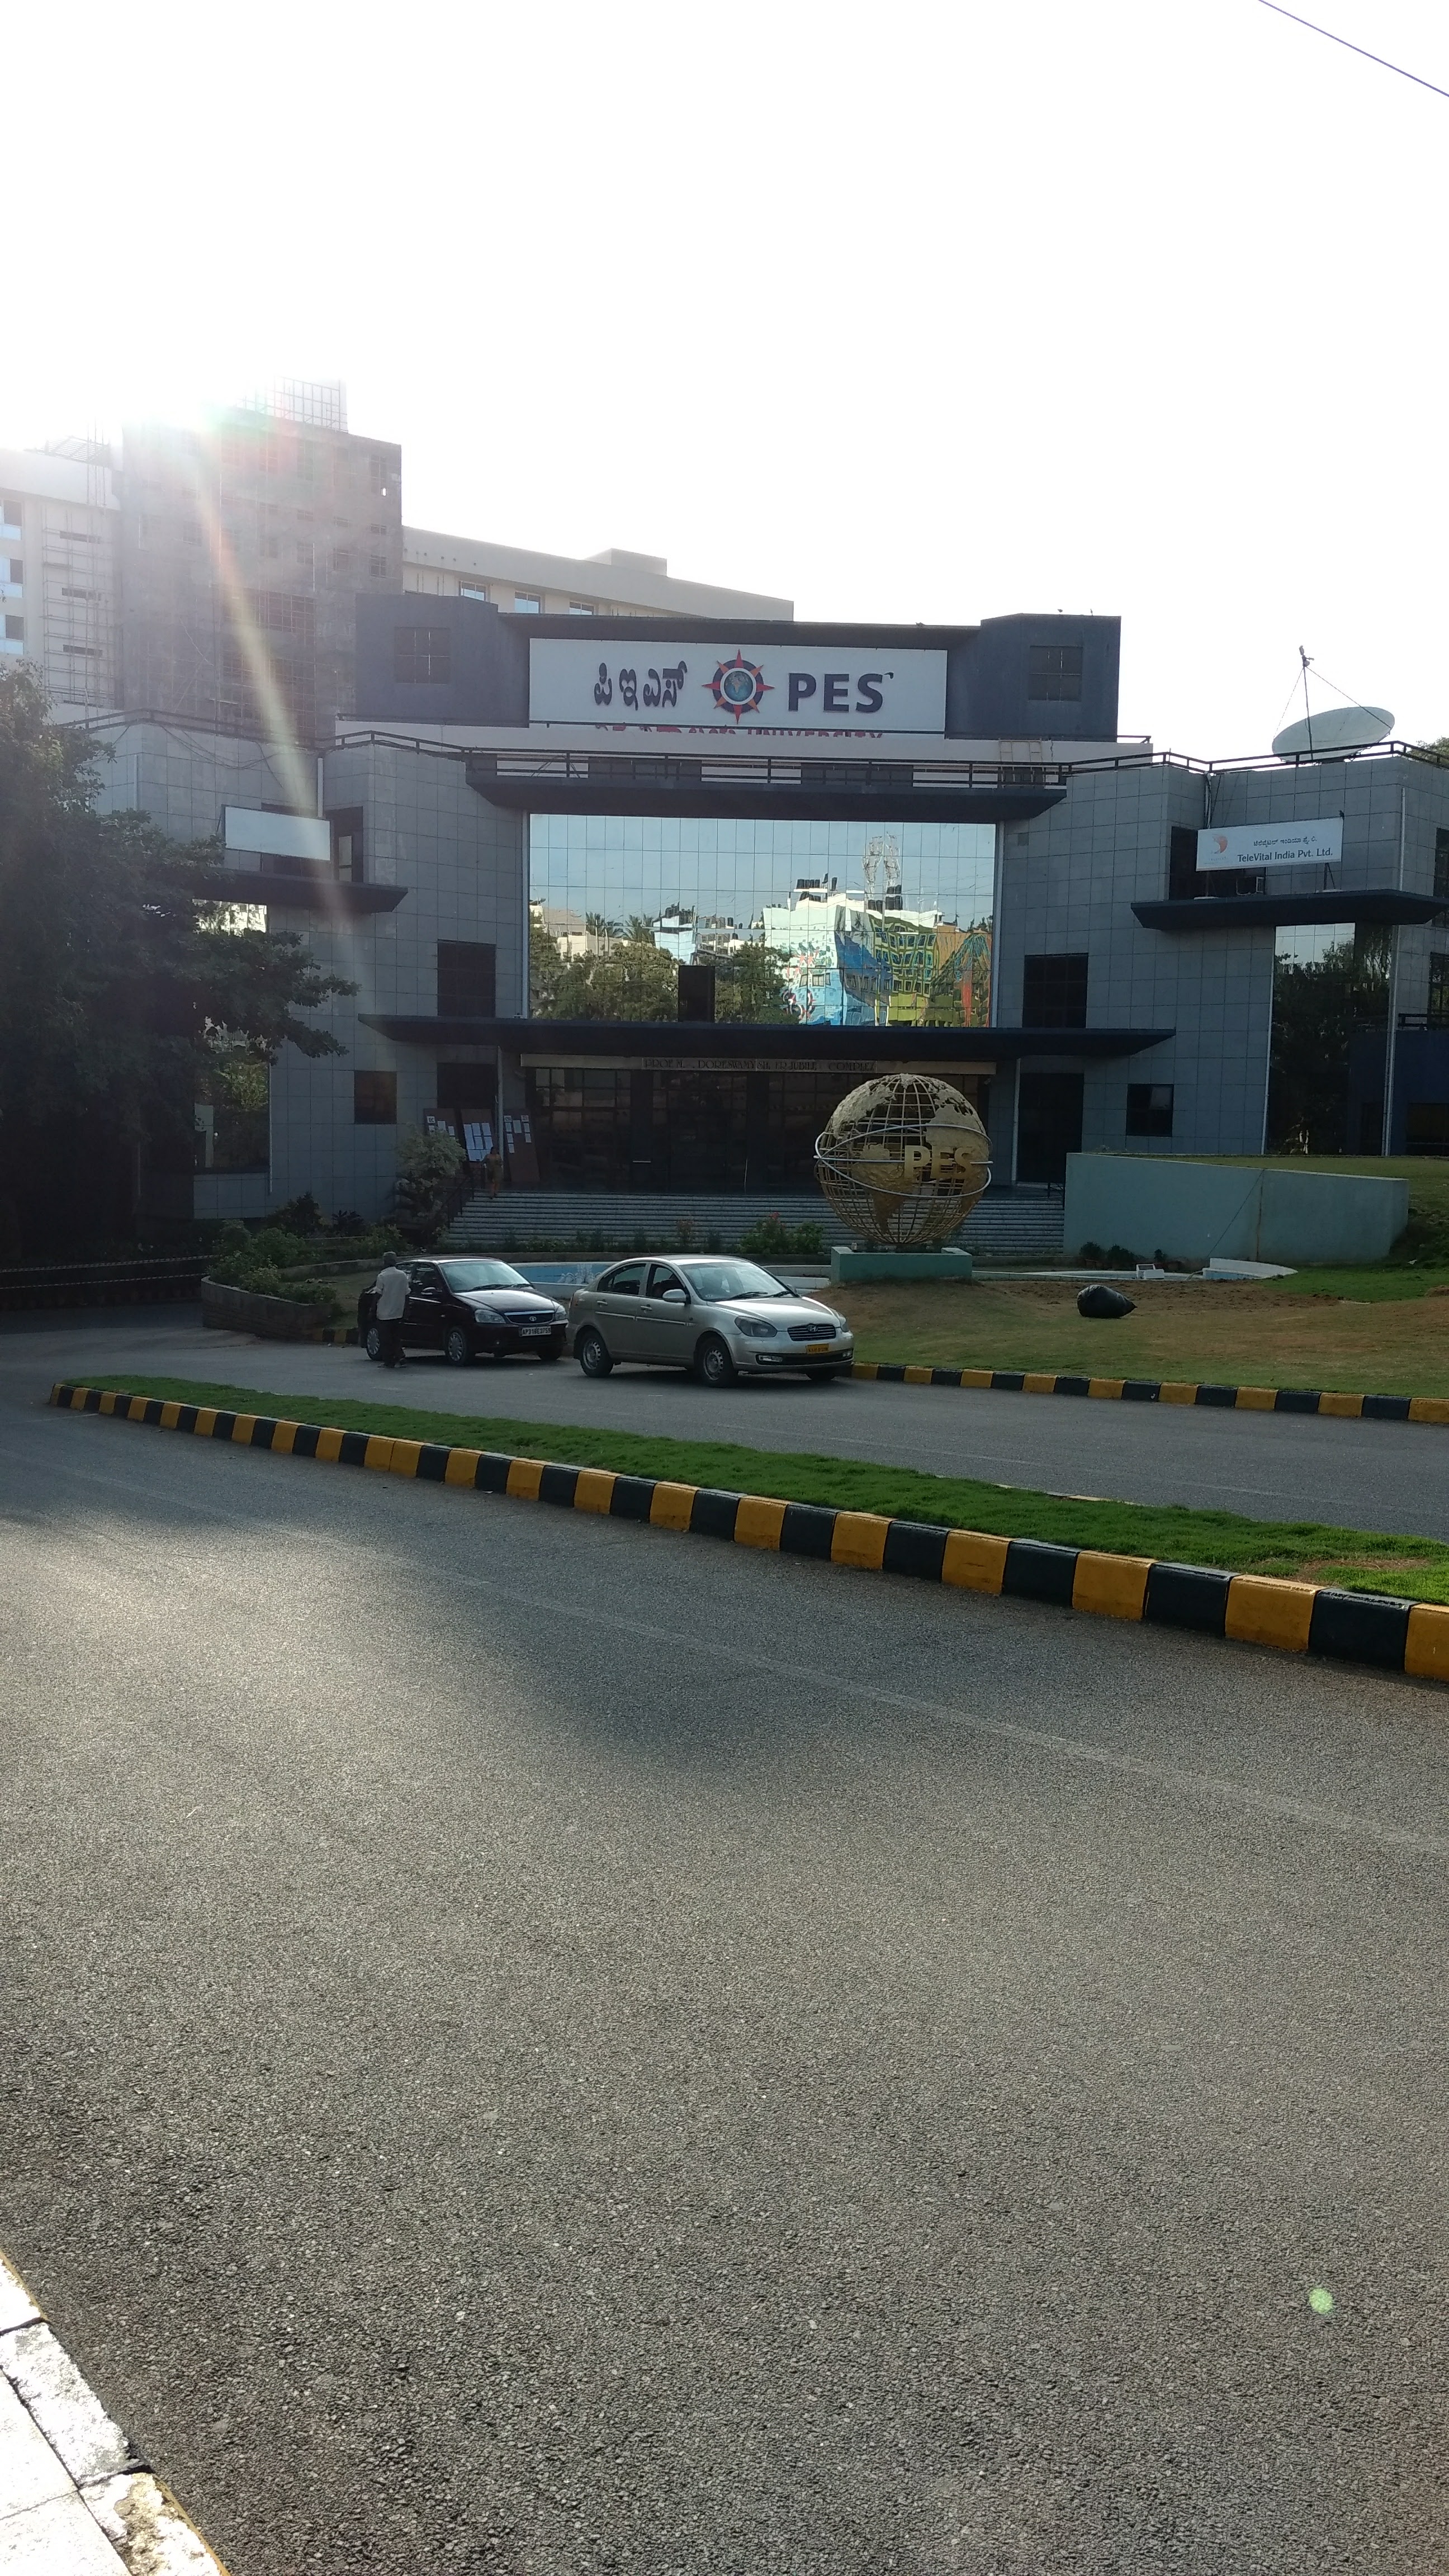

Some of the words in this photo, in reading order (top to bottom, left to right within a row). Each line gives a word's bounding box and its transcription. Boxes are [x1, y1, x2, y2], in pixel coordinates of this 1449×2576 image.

[788, 673, 883, 713] PES
[1238, 852, 1272, 862] TeleVital
[1275, 851, 1295, 860] India
[1298, 849, 1314, 858] Pvt.
[1316, 847, 1333, 856] Ltd.
[904, 1145, 972, 1179] PES
